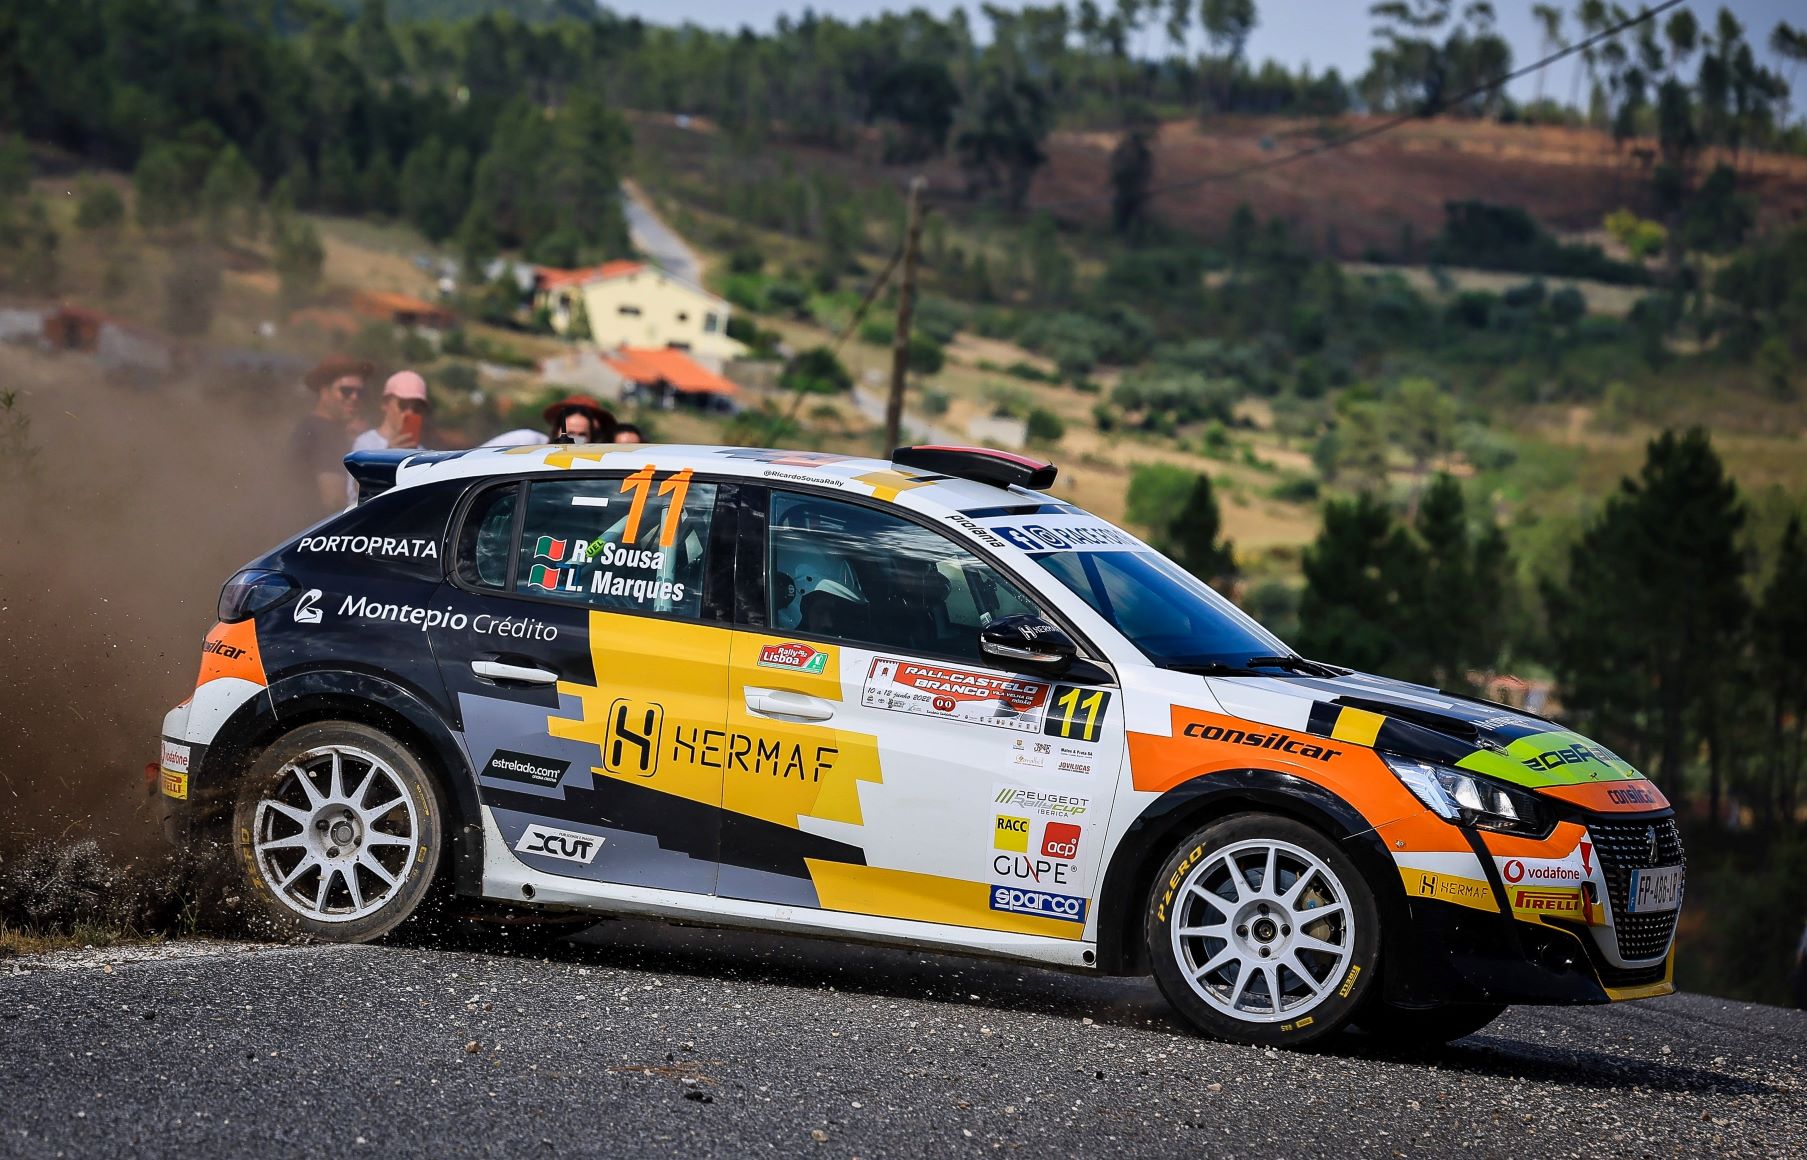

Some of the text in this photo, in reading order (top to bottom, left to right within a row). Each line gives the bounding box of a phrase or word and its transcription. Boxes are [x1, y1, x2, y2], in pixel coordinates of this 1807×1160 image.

[763, 470, 844, 487] @RicardoSousaRally
[619, 464, 694, 548] 11
[297, 535, 438, 559] PORTOPRATA
[571, 539, 665, 570] R. Sousa
[586, 539, 604, 556] UEL
[565, 567, 685, 603] L. Marques
[337, 595, 559, 642] Montepio Crédito
[763, 651, 800, 665] Lisboa
[904, 666, 1039, 694] RALI CASTELO
[914, 679, 990, 697] BRANCO
[1058, 687, 1104, 740] 11
[1183, 722, 1342, 762] consilcar
[672, 726, 839, 783] HERMAF
[491, 759, 558, 779] estrelado.com
[1016, 790, 1090, 807] PEUGEOT
[1037, 808, 1069, 818] IBERICA
[997, 817, 1028, 833] RACC
[1047, 841, 1076, 857] acp
[1527, 867, 1581, 881] vodafone
[1440, 881, 1489, 899] HERMAF
[995, 888, 1080, 915] sparco
[1514, 890, 1580, 911] PIRELLI
